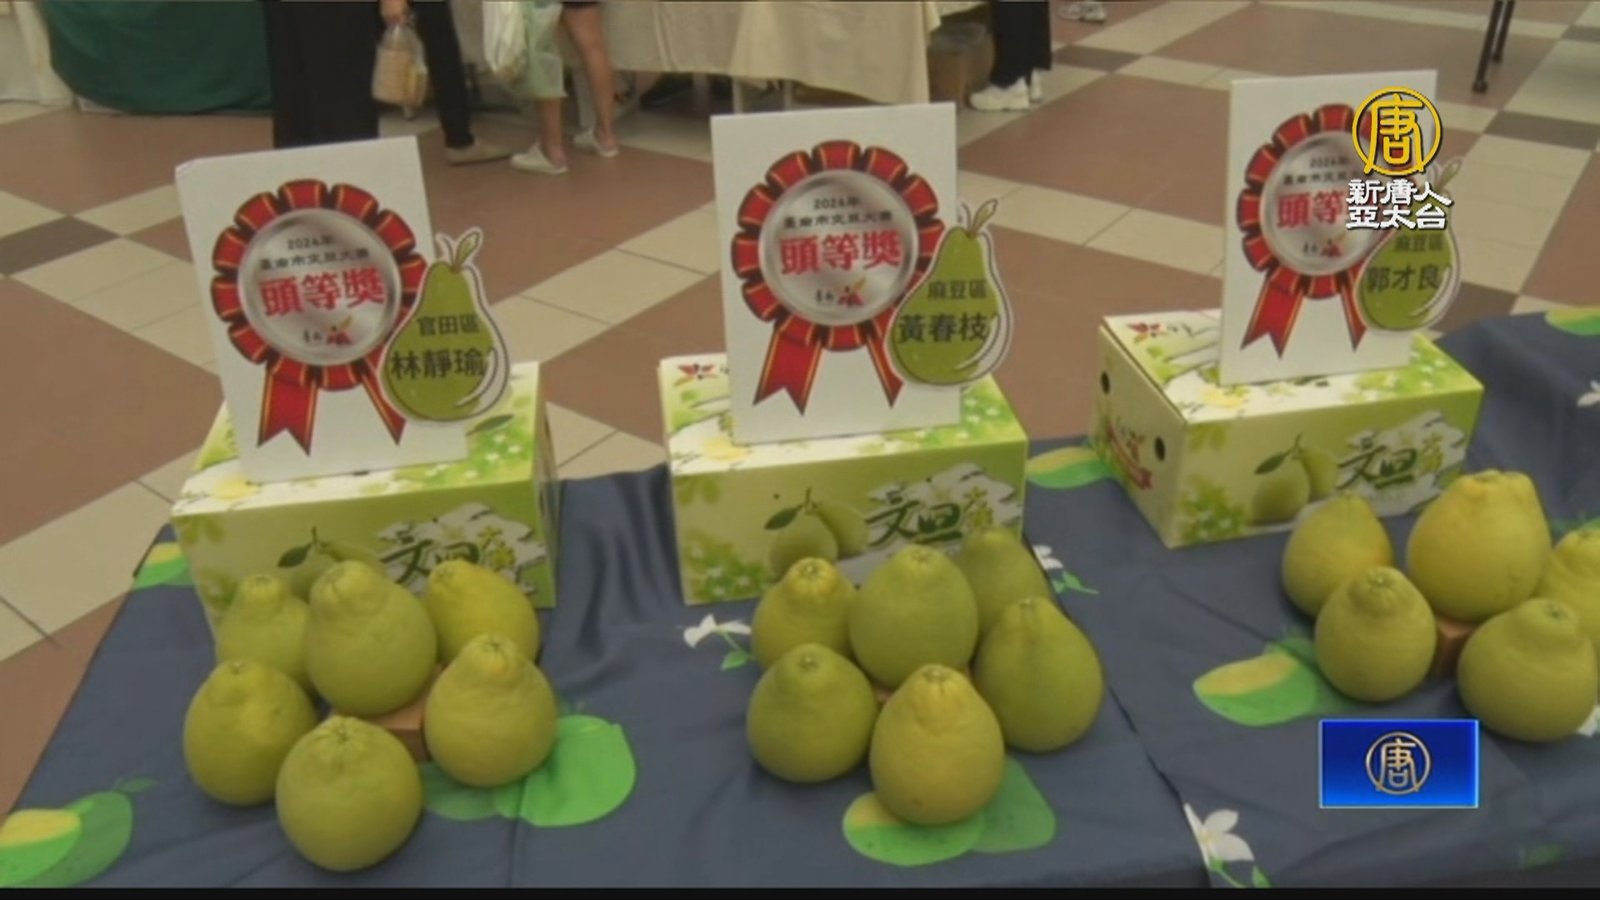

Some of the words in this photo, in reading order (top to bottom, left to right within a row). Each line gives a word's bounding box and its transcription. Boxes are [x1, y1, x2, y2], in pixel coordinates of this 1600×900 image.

[814, 197, 860, 210] 2024年
[1278, 189, 1345, 229] 頭等
[286, 235, 334, 250] 2024年
[780, 229, 902, 275] 頭等獎
[258, 265, 386, 317] 頭等獎
[927, 279, 988, 300] 麻豆區
[1367, 263, 1440, 293] 郭才良
[417, 313, 481, 337] 官田區
[898, 312, 988, 343] 黃春枝
[391, 347, 487, 380] 林靜瑜
